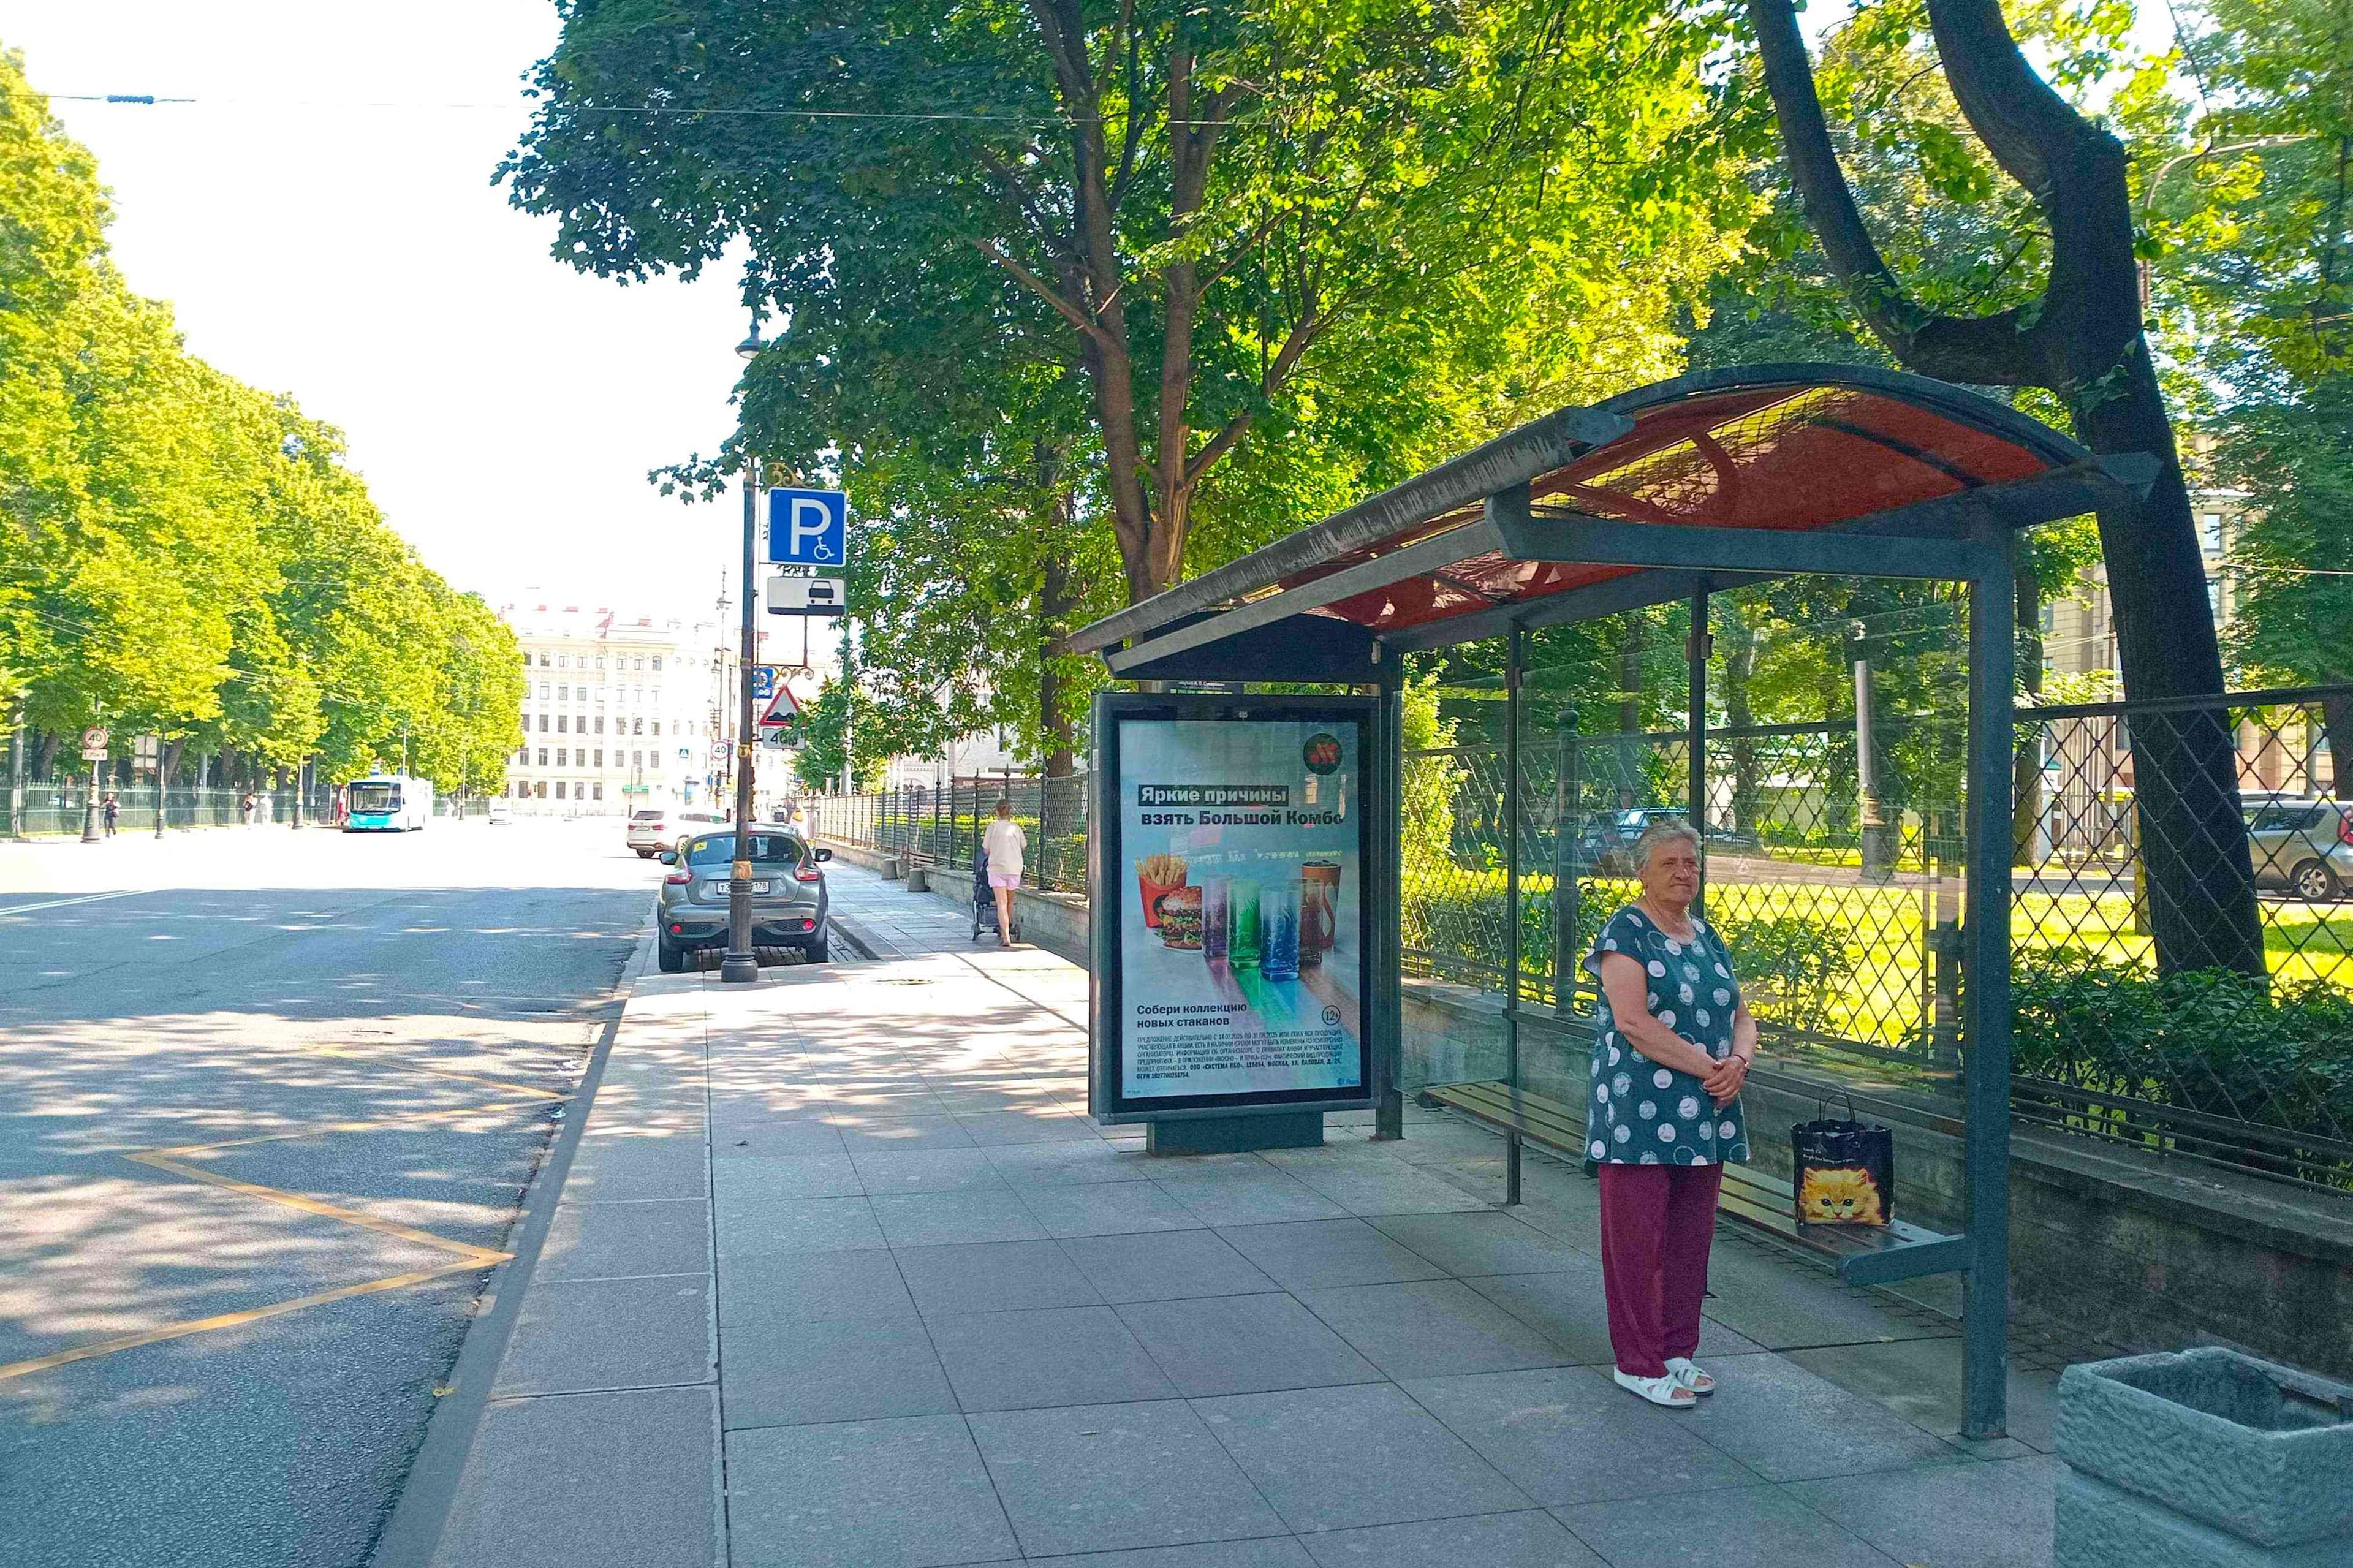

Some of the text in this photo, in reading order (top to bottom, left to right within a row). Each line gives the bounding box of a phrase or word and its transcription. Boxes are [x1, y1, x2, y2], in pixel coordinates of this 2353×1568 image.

[790, 498, 832, 555] P
[1142, 787, 1286, 804] Яркие причины
[1142, 809, 1344, 825] взять Большой Комбо
[1137, 1003, 1247, 1017] Собери коллекцию
[1325, 1011, 1339, 1021] 12+
[1137, 1016, 1229, 1028] новых стаканов
